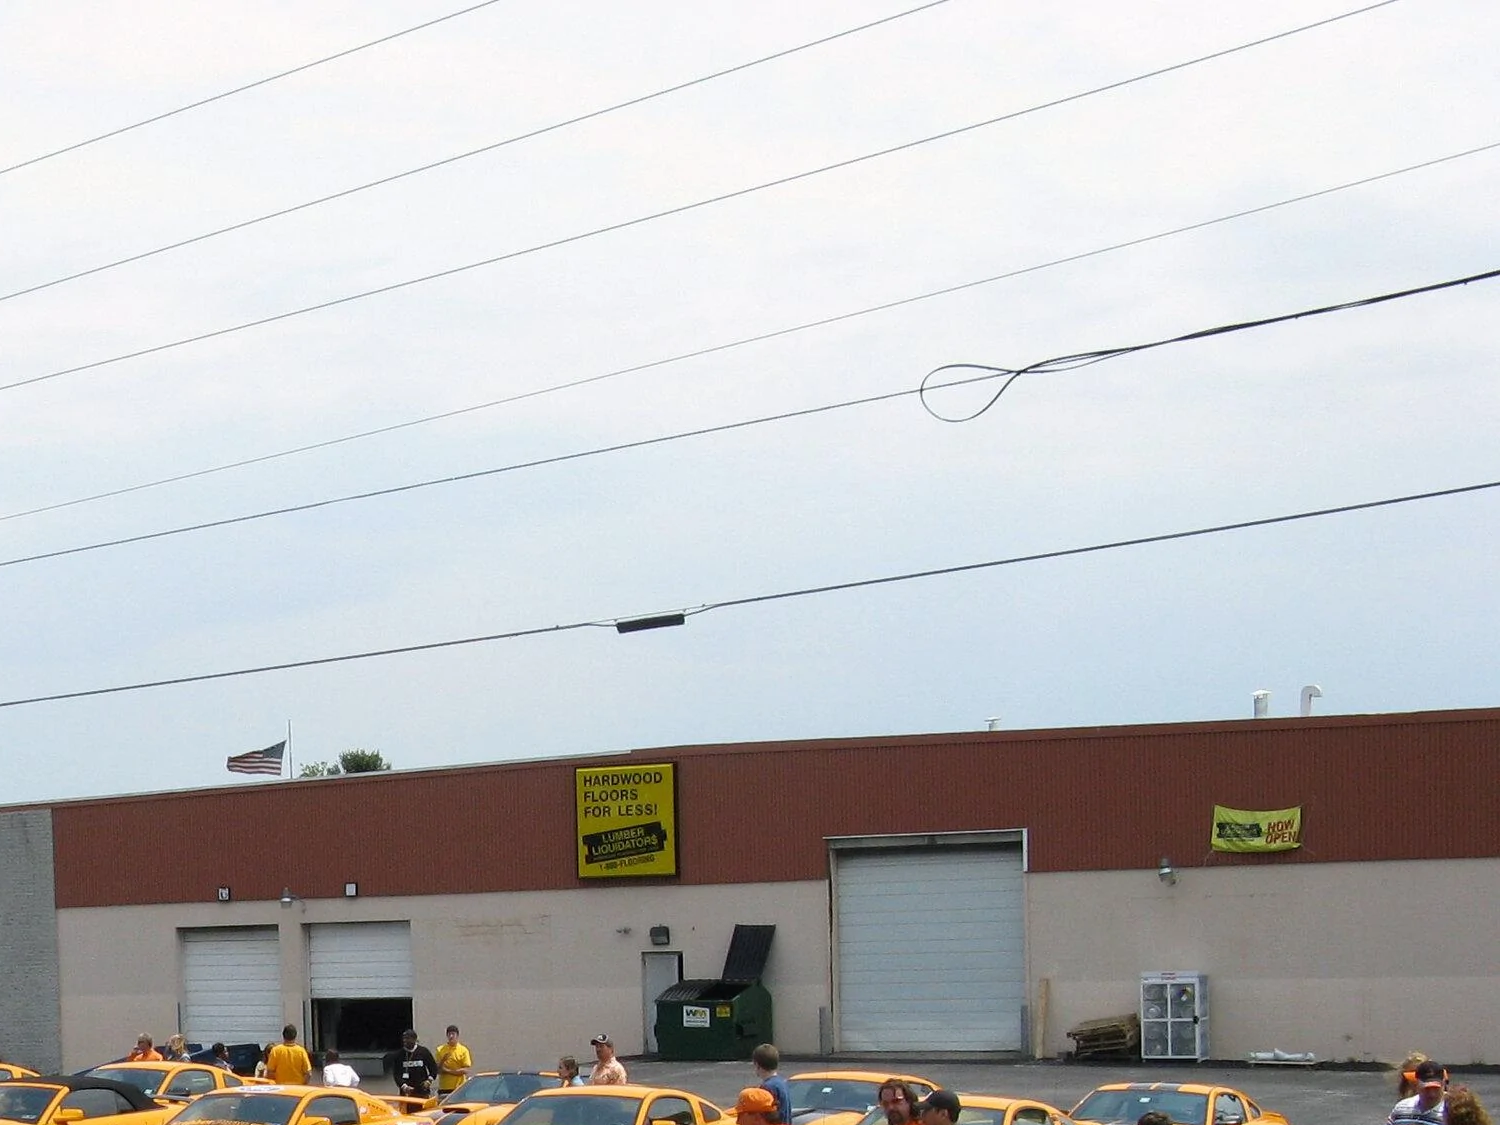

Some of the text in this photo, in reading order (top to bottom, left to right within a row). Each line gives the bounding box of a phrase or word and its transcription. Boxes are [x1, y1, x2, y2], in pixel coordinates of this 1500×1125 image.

[583, 772, 663, 787] HARDWOOD
[583, 788, 639, 803] FLOORS
[584, 803, 658, 818] FOR LESS!
[602, 826, 645, 843] LUMBER
